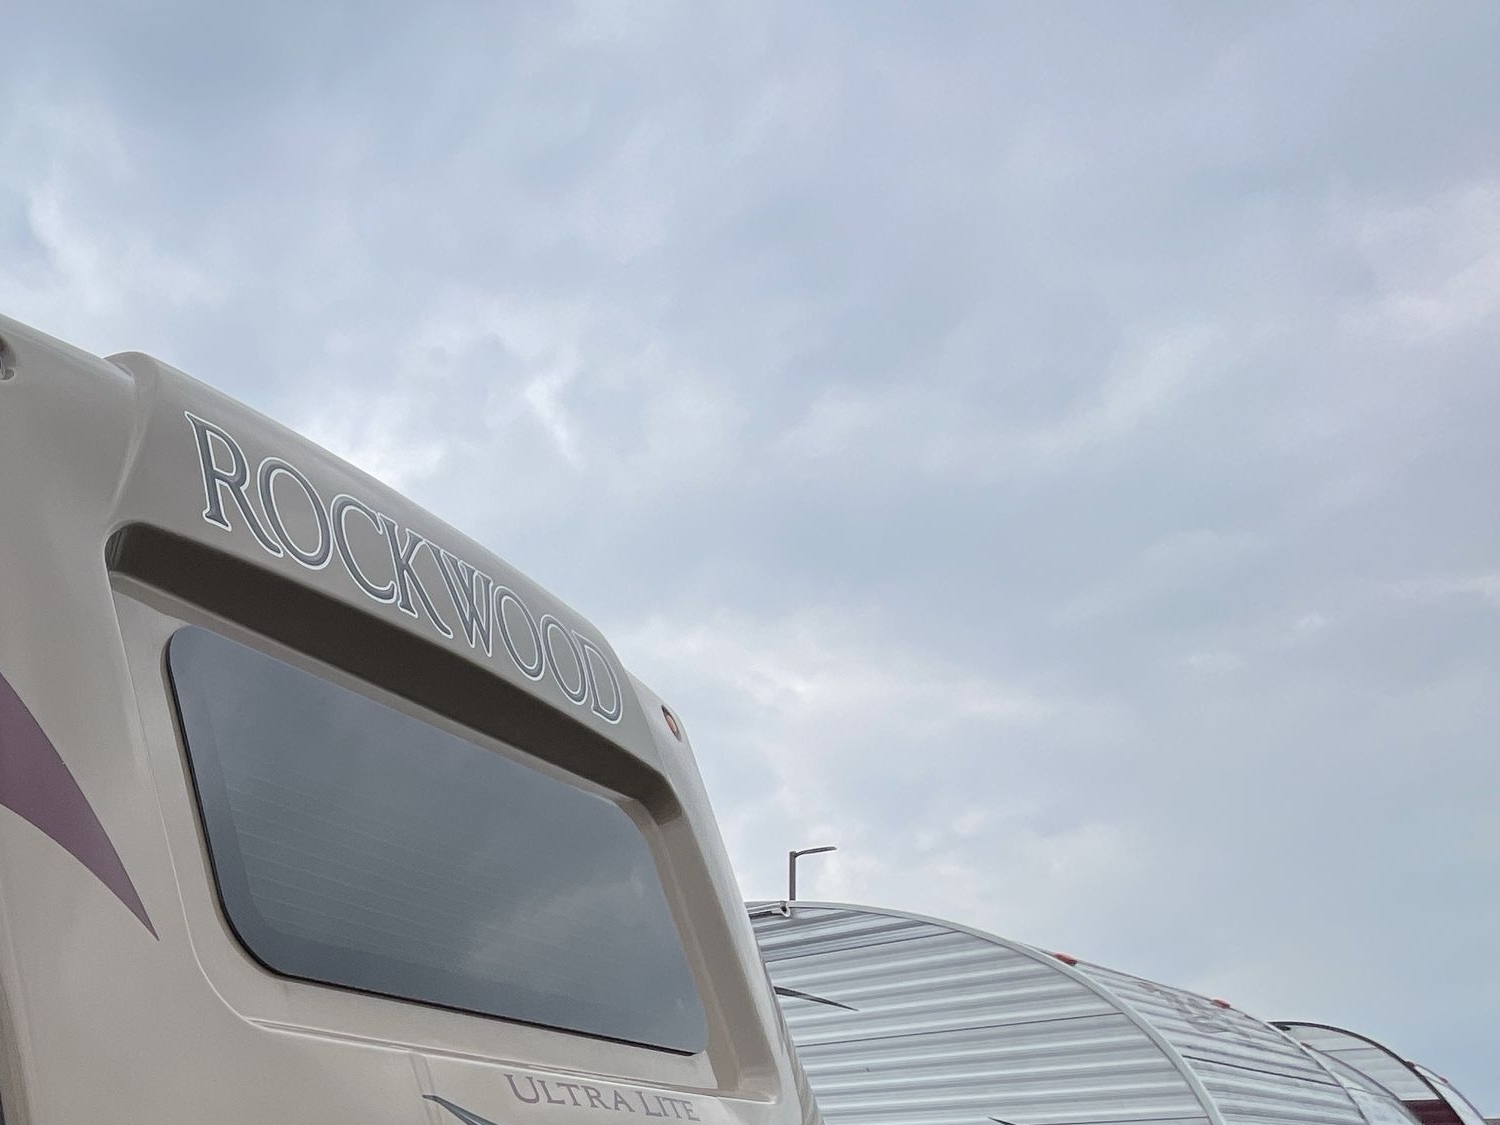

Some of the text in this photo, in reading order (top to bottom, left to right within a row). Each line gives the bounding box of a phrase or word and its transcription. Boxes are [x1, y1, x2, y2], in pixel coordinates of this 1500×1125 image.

[185, 411, 623, 725] ROCKWOOD
[504, 1073, 700, 1121] ULTRA LITE
